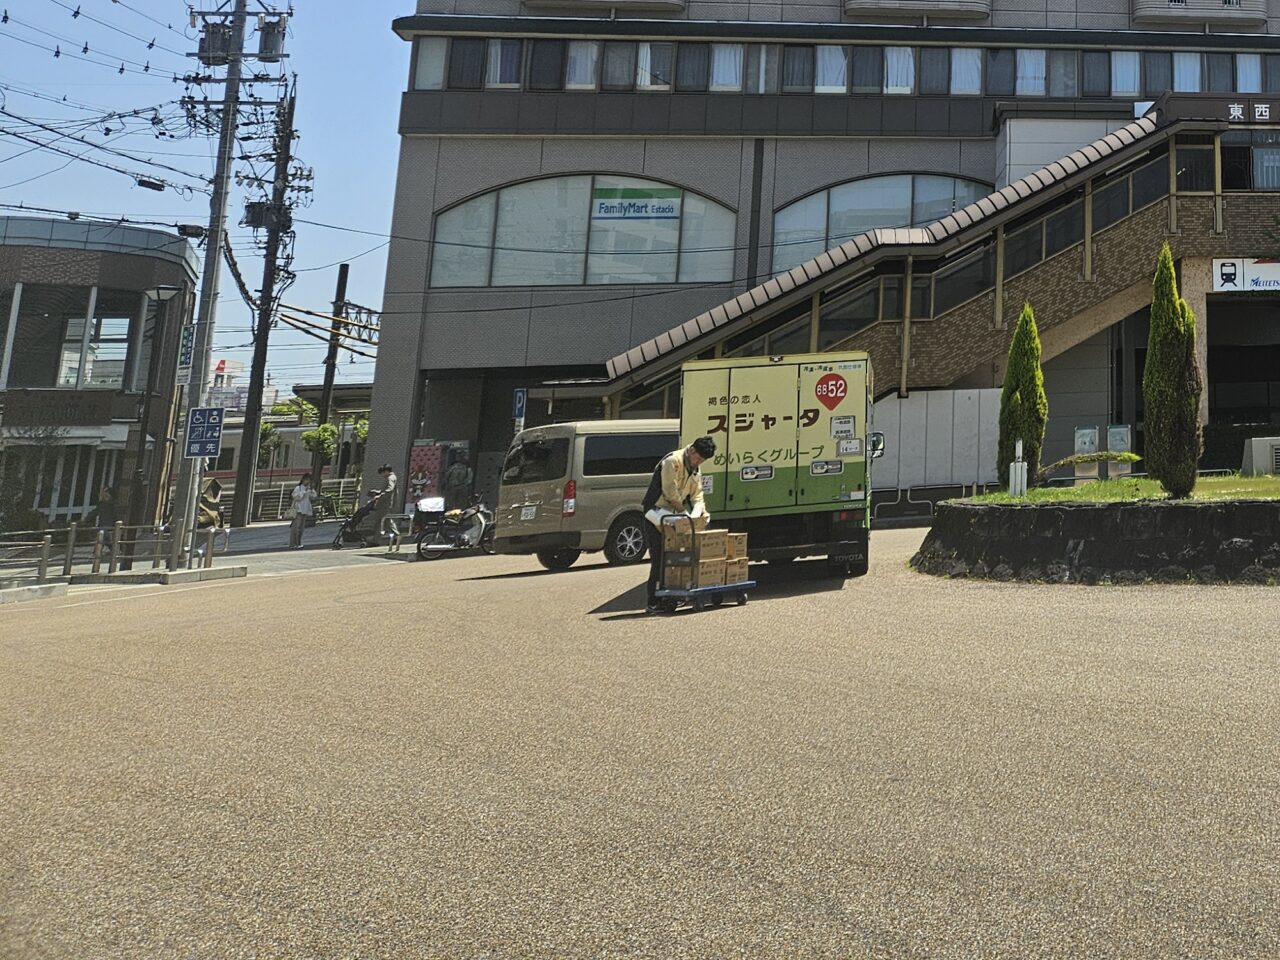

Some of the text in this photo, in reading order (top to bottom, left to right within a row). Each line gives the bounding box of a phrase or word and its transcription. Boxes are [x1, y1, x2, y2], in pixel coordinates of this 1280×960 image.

[598, 202, 674, 216] FamilyMart Estació
[816, 379, 846, 397] 6852
[515, 391, 524, 413] P
[708, 394, 762, 406] 褐色の恋人
[706, 408, 820, 435] スジャータ
[190, 443, 216, 453] 優先
[713, 444, 825, 466] めいらくグループ
[834, 553, 864, 561] TOYOTA
